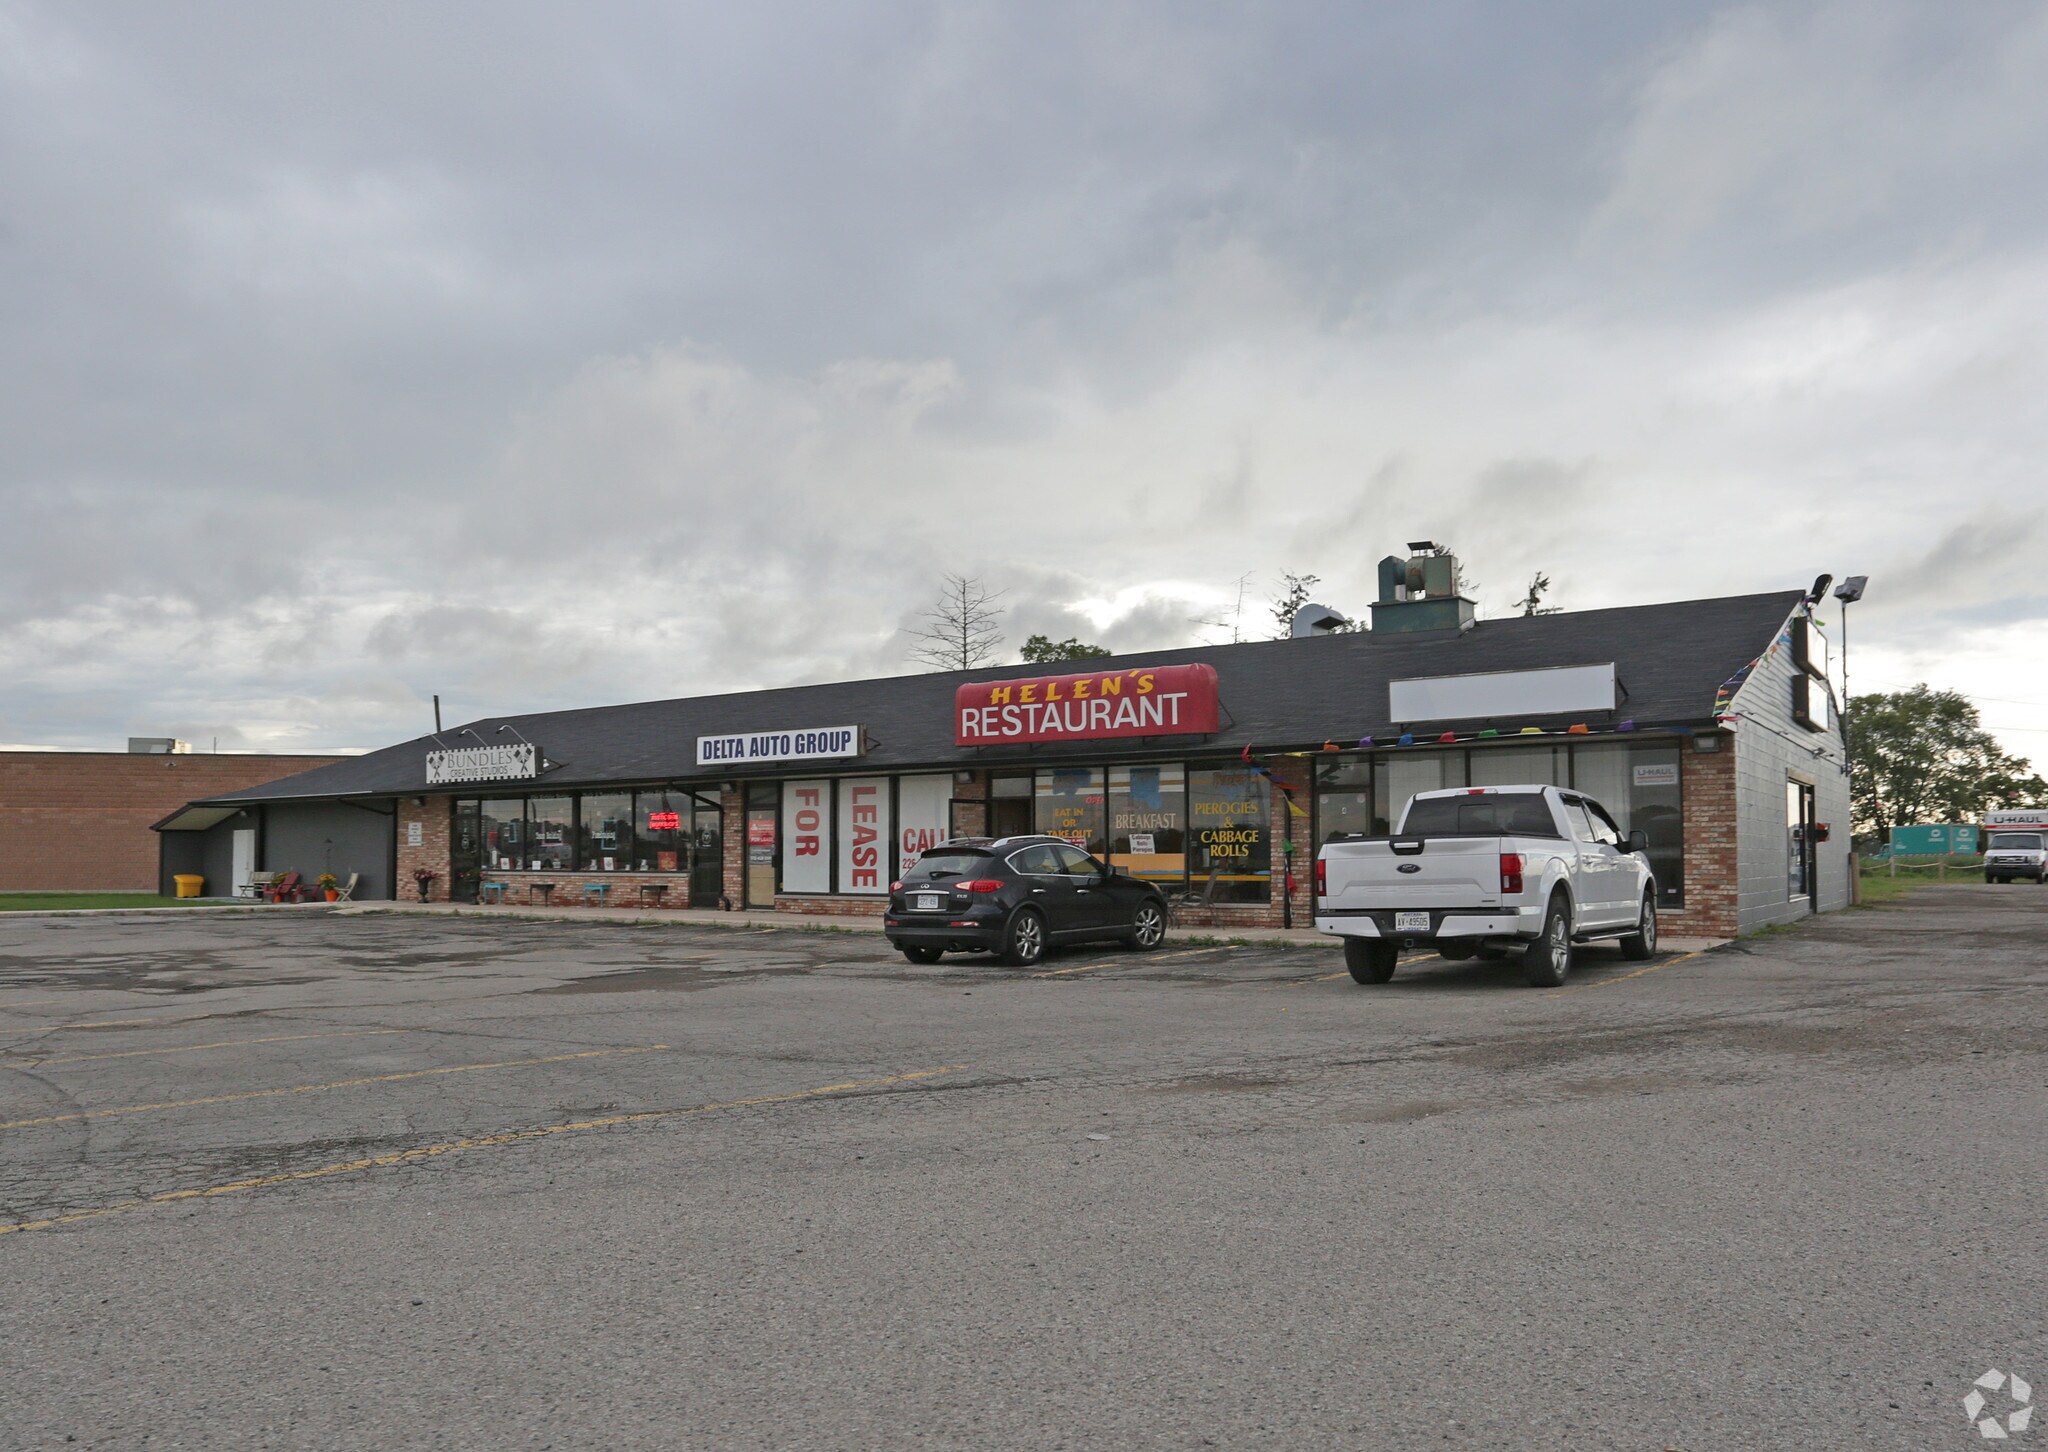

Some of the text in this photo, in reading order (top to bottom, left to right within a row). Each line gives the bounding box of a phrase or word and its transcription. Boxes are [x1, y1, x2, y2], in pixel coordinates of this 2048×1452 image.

[990, 670, 1154, 705] HELEN'S
[962, 692, 1188, 738] RESTAURANT
[703, 731, 851, 760] DELTA AUTO GROUP
[447, 751, 512, 769] BUNDLES
[450, 766, 508, 777] CREATIVE STUDIOS
[1055, 808, 1084, 817] EAT IN
[1195, 801, 1258, 815] PIEROGIES
[795, 788, 819, 856] FOR
[1062, 819, 1076, 828] OR
[1115, 813, 1176, 829] BREAKFAST
[1224, 816, 1234, 828] &
[852, 786, 877, 887] LEASE
[1046, 829, 1093, 838] TAKE OUT
[1200, 830, 1259, 844] CABBAGE
[1210, 844, 1249, 857] ROLLS
